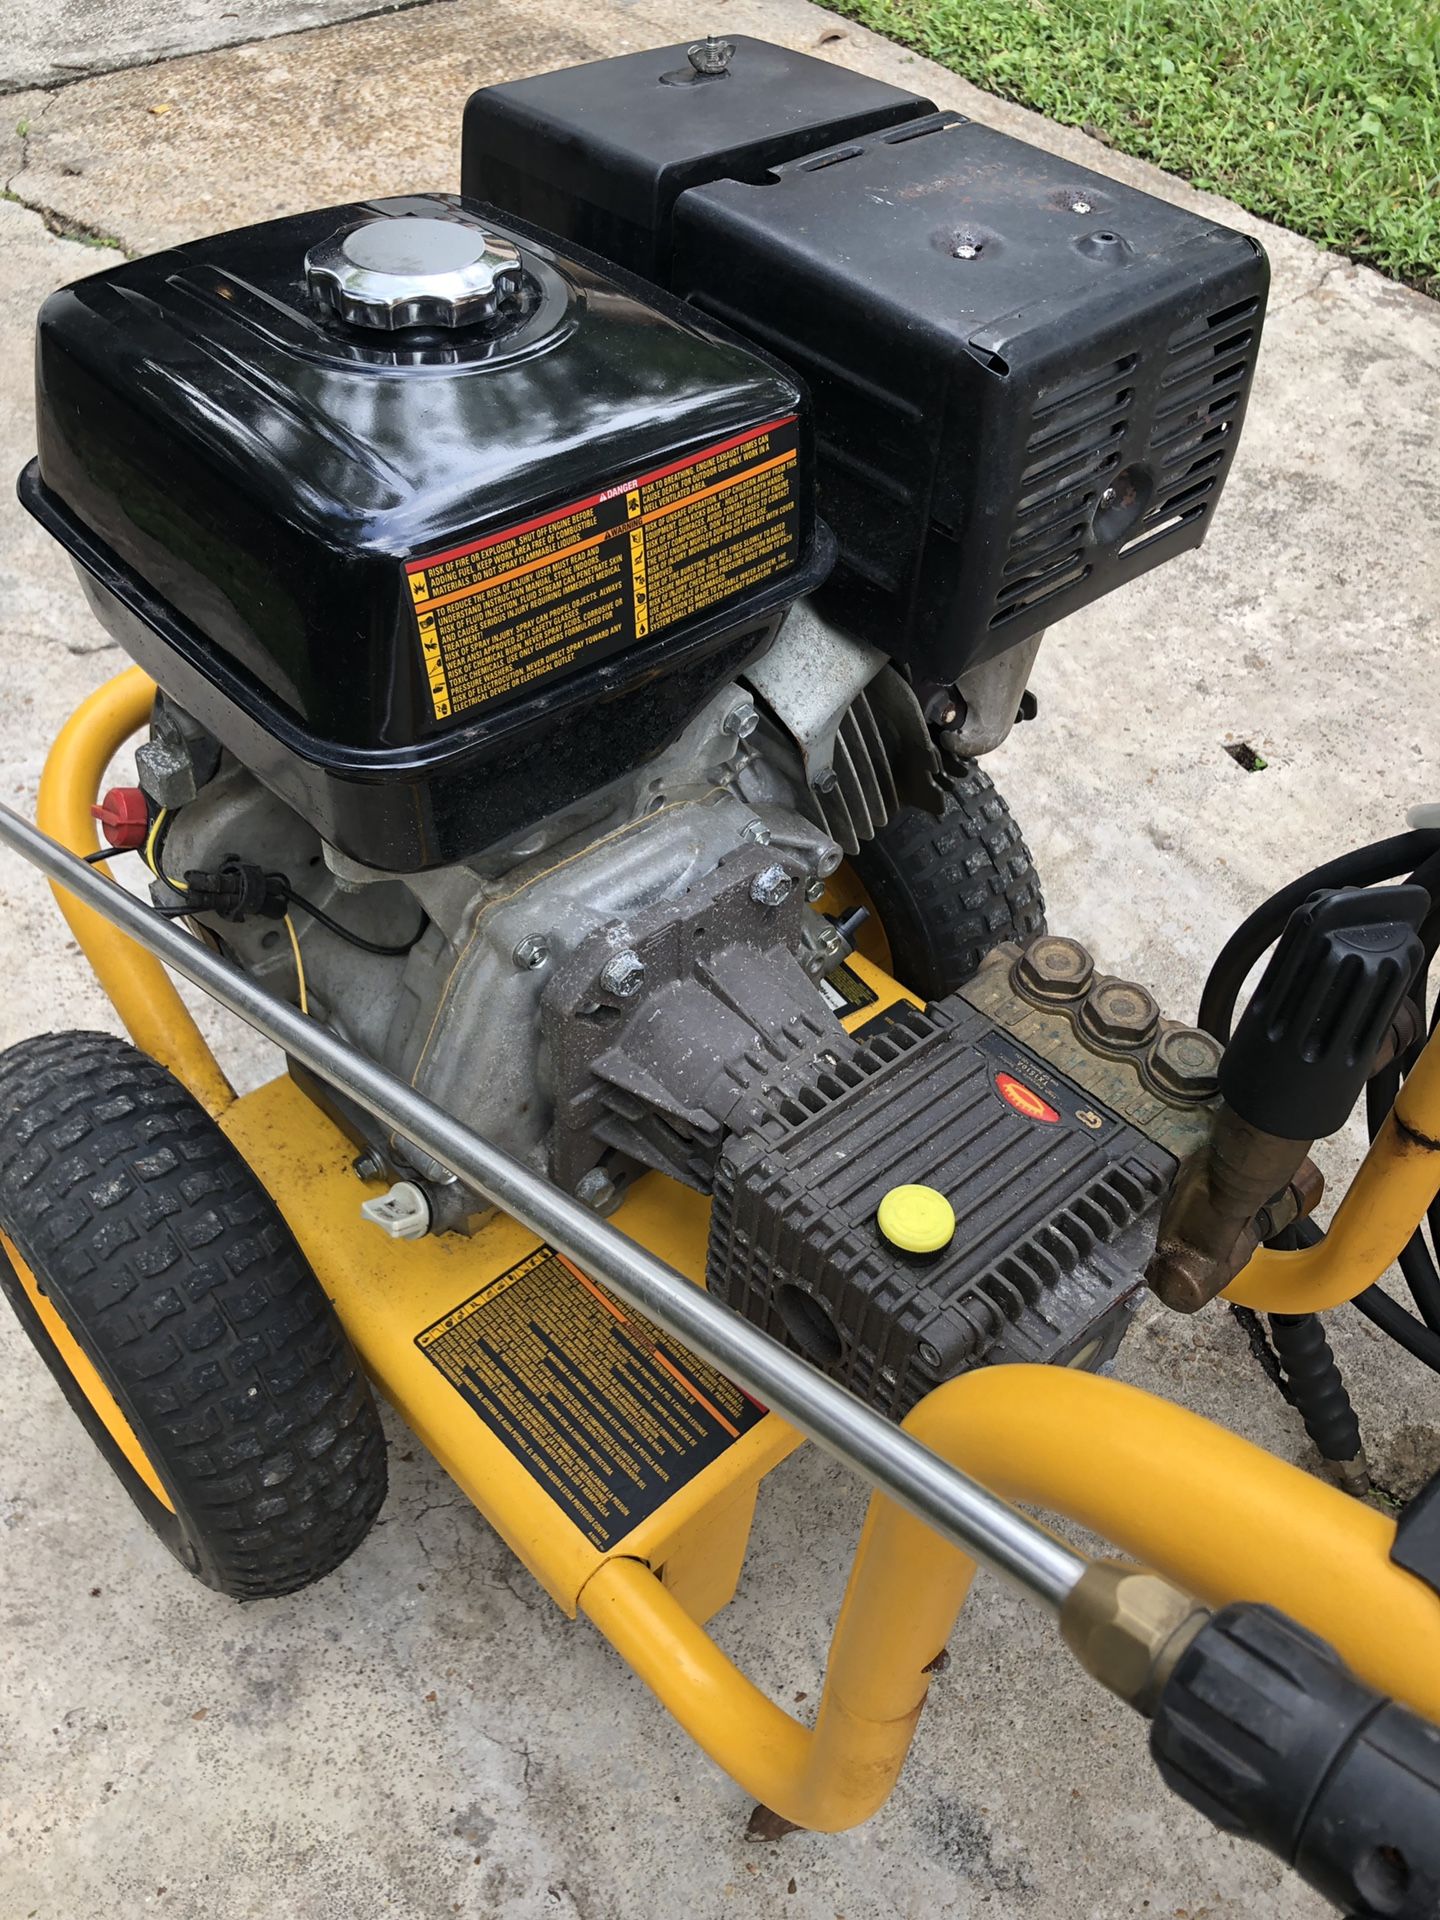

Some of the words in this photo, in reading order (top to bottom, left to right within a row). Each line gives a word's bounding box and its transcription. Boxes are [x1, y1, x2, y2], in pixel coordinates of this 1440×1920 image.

[607, 479, 638, 499] DANGER
[642, 483, 654, 495] RISK
[656, 479, 662, 489] TO
[664, 466, 695, 486] BREATHING.
[696, 457, 715, 472] ENGINE
[717, 447, 739, 463] EXHAUST
[741, 439, 757, 453] FUMES
[758, 434, 768, 445] CAN
[643, 490, 660, 504] CAUSE
[662, 481, 680, 496] DEATH.
[681, 477, 691, 488] FOR
[693, 466, 717, 483] OUTDOOR
[718, 461, 727, 472] USE
[729, 455, 742, 467] ONLY.
[744, 448, 758, 461] WORK
[760, 445, 765, 454] IN
[766, 443, 769, 451] A
[611, 517, 643, 537] WARNING
[643, 500, 657, 513] WELL
[659, 486, 690, 507] VENTILATED
[692, 480, 706, 493] AREA.
[428, 565, 444, 578] RISK
[445, 562, 454, 572] OF
[455, 556, 469, 568] FIRE
[471, 552, 480, 563] OR
[519, 531, 535, 545] SHUT
[537, 527, 547, 538] OFF
[548, 517, 570, 533] ENGINE
[572, 508, 593, 524] BEFORE
[431, 571, 457, 588] ADDING
[477, 558, 493, 571] KEEP
[494, 550, 513, 564] WORK
[514, 543, 530, 556] AREA
[532, 537, 545, 550] FREE
[547, 534, 554, 543] OF
[556, 517, 596, 540] COMBUSTIBLE
[432, 576, 471, 597] MATERIALS.
[473, 572, 482, 582] DO
[483, 566, 496, 578] NOT
[498, 558, 517, 572] SPRAY
[519, 543, 555, 564] FLAMMABLE
[437, 607, 445, 617] TO
[447, 597, 472, 614] REDUCE
[473, 592, 485, 603] THE
[487, 586, 501, 598] RISK
[502, 583, 510, 592] OF
[536, 566, 551, 579] USER
[552, 559, 568, 572] MUST
[571, 552, 585, 565] READ
[587, 546, 599, 557] AND
[438, 603, 482, 627] UNDERSTAND
[483, 586, 524, 609] INSTRUCTION
[525, 575, 552, 592] MANUAL.
[554, 567, 572, 581] STORE
[440, 623, 455, 636] RISK
[456, 620, 464, 629] OF
[466, 612, 484, 626] FLUID
[520, 590, 537, 604] FLUID
[538, 580, 562, 596] STREAM
[563, 574, 575, 586] CAN
[577, 560, 607, 580] PENETRATE
[609, 554, 622, 566] SKIN
[442, 633, 456, 644] AND
[457, 624, 478, 638] CAUSE
[480, 613, 506, 629] SERIOUS
[507, 603, 529, 618] INJURY
[530, 590, 561, 609] REQUIRING
[563, 575, 594, 595] IMMEDIATE
[596, 564, 620, 581] MEDICAL
[443, 630, 484, 653] TREATMENT!
[445, 650, 459, 662] RISK
[461, 646, 469, 656] OF
[470, 637, 490, 652] SPRAY
[516, 619, 534, 632] SPRAY
[536, 613, 548, 624] CAN
[550, 603, 570, 618] PROPEL
[572, 591, 598, 609] OBJECTS.
[600, 581, 622, 597] ALWAYS
[446, 657, 465, 671] WEAR
[467, 650, 482, 662] ANSI
[483, 636, 515, 655] APPROVED
[532, 620, 552, 635] SAFETY
[448, 667, 462, 680] RISK
[464, 664, 471, 673] OF
[473, 650, 503, 669] CHEMICAL
[525, 633, 543, 647] NEVER
[544, 624, 562, 638] SPRAY
[564, 615, 582, 629] ACIDS.
[583, 602, 613, 621] CORROSIVE
[615, 597, 622, 607] OR
[450, 674, 468, 688] TOXIC
[507, 653, 518, 663] USE
[519, 646, 533, 658] ONLY
[535, 633, 563, 651] CLEANERS
[565, 616, 601, 638] FORMULATED
[602, 611, 612, 621] FOR
[451, 677, 482, 696] PRESSURE
[484, 663, 514, 682] WASHERS.
[452, 693, 466, 705] RISK
[468, 689, 475, 698] OF
[526, 658, 544, 672] NEVER
[546, 649, 564, 663] DIRECT
[566, 640, 584, 654] SPRAY
[586, 629, 609, 645] TOWARD
[611, 623, 621, 634] ANY
[454, 692, 488, 713] ELECTRICAL
[490, 682, 510, 697] DEVICE
[512, 678, 519, 687] OR
[521, 663, 552, 683] ELECTRICAL
[1016, 1060, 1049, 1086] TX1510A
